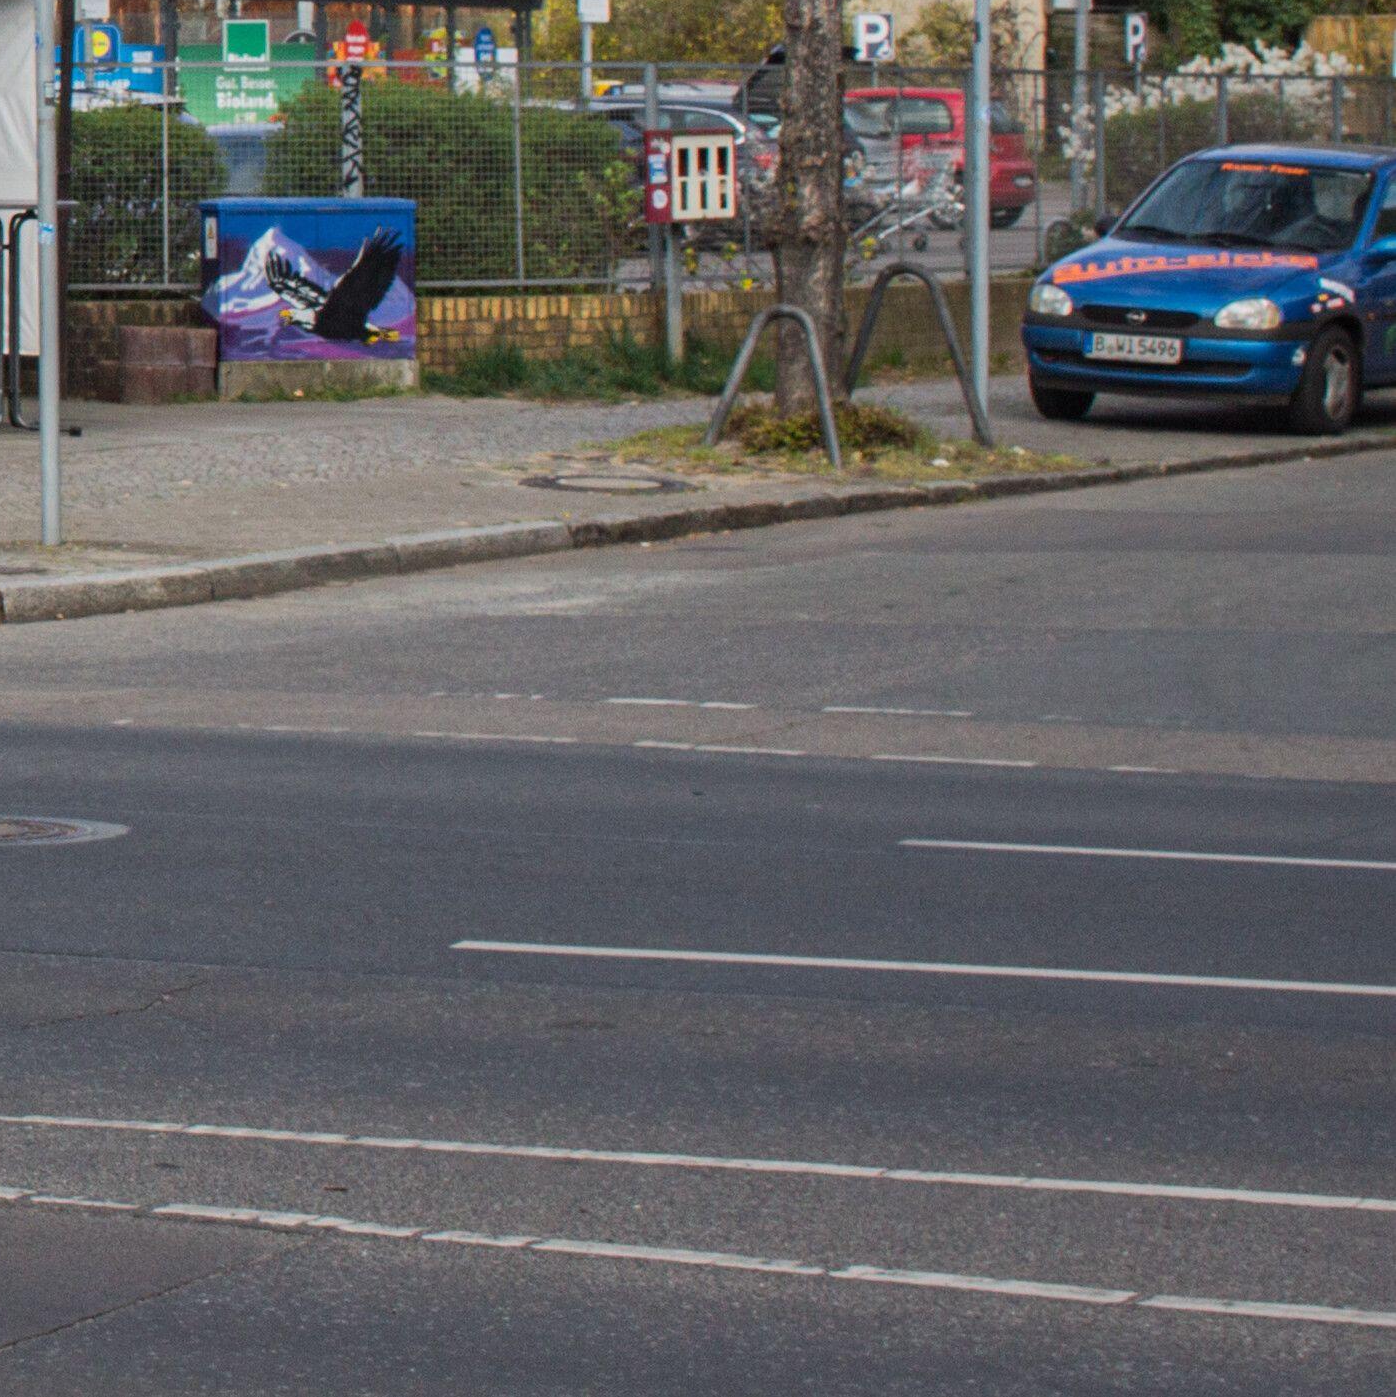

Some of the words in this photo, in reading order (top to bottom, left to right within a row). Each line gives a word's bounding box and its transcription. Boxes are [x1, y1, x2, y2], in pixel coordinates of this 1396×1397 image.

[855, 13, 890, 61] P
[1094, 336, 1104, 351] B
[1137, 338, 1177, 357] 5496
